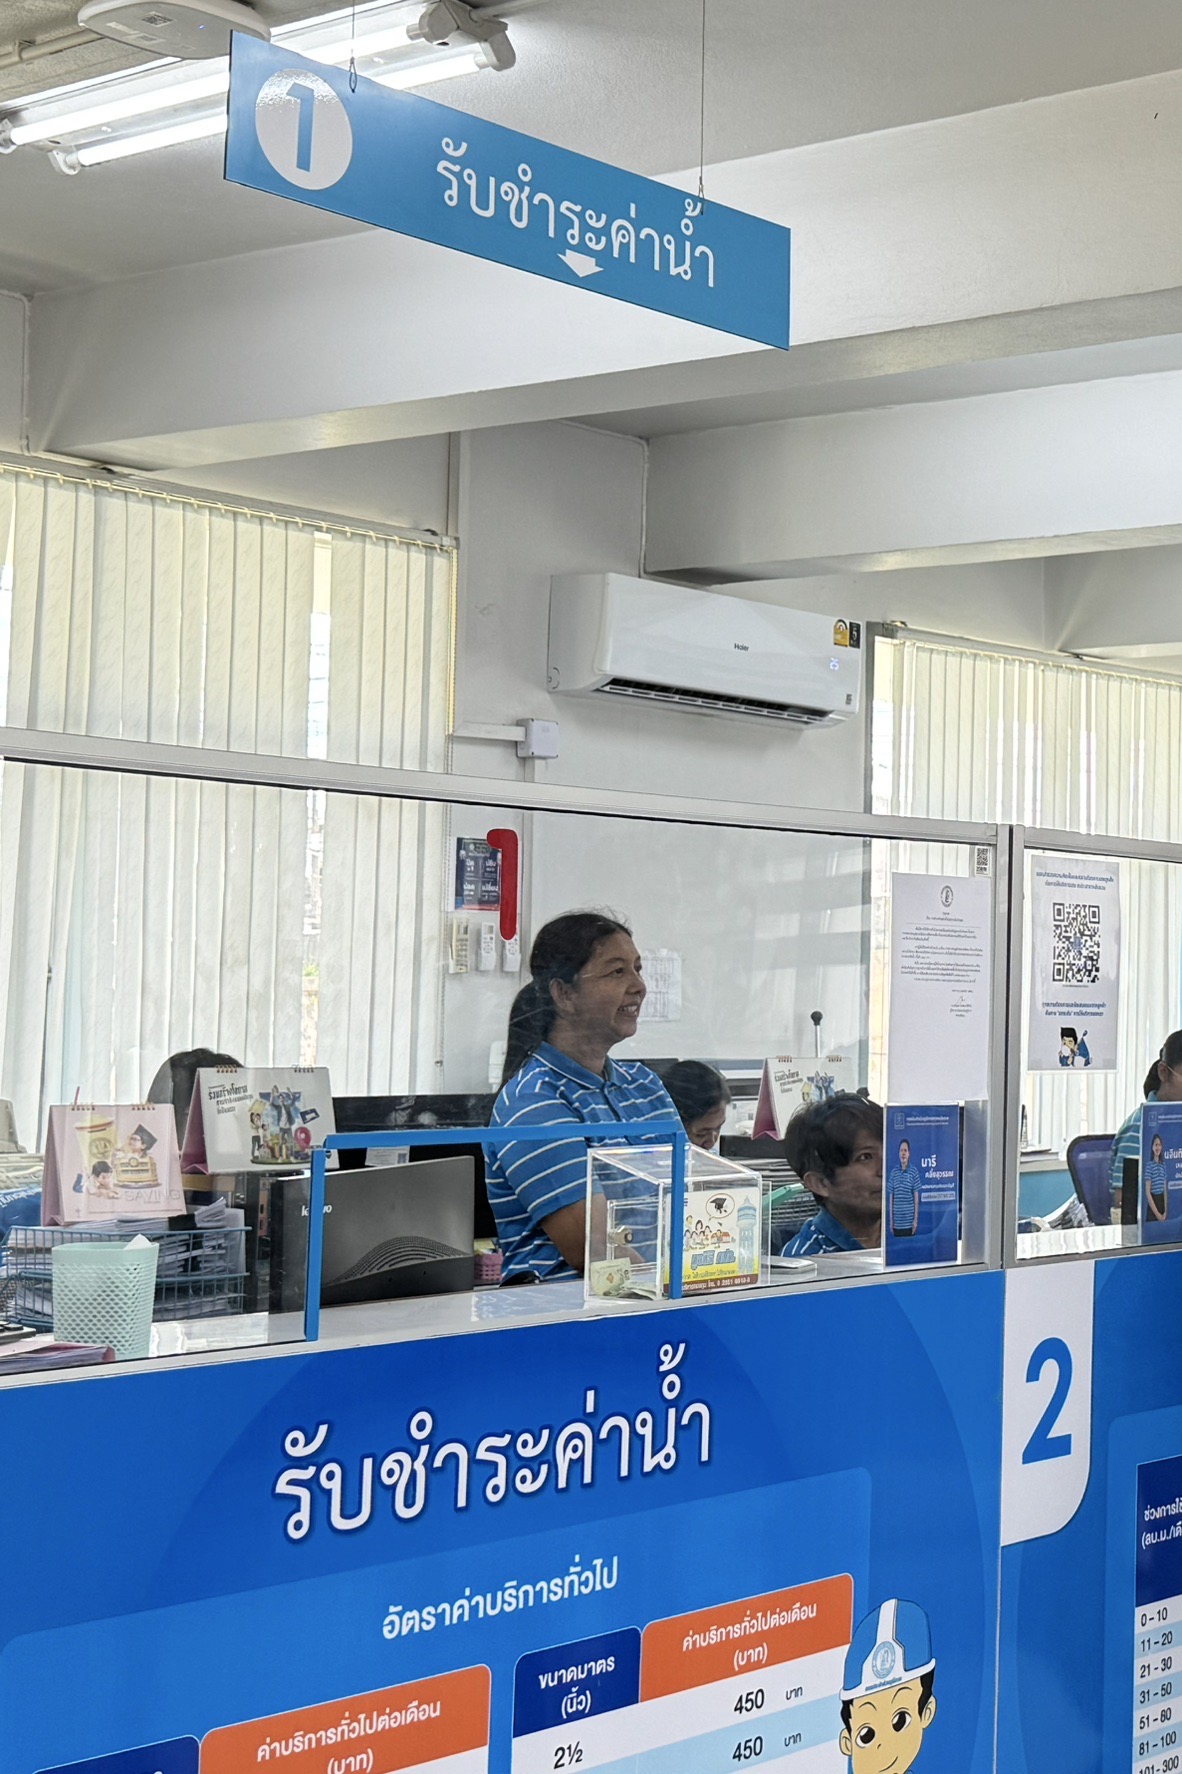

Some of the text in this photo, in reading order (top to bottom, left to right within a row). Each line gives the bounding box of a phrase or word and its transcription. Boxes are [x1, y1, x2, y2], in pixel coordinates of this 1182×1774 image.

[286, 82, 314, 173] 1
[436, 136, 715, 287] รับชำระค่าน้ำ
[487, 828, 518, 941] 1
[1022, 1337, 1073, 1465] 2
[274, 1342, 712, 1541] รับชำระค่าน้ำ
[382, 1554, 618, 1640] อัตราค่าบริการทั่วไป
[682, 1601, 817, 1653] ค่าบริการทั่วไปต่อเดือน
[1141, 1613, 1147, 1627] 0
[1157, 1607, 1168, 1622] 10
[733, 1641, 769, 1671] (บาท)
[1141, 1639, 1151, 1652] 11
[1161, 1631, 1173, 1646] 20
[538, 1654, 616, 1690] ขนาดมาตร
[1140, 1665, 1150, 1678] 21
[1161, 1656, 1172, 1672] 30
[560, 1685, 592, 1719] (นิ้ว)
[733, 1684, 803, 1716] 450 บาท
[1139, 1690, 1150, 1704] 31
[256, 1700, 442, 1762] ค่าบริการทั่วไปต่อเดือน
[1139, 1715, 1150, 1730] 51
[1160, 1707, 1172, 1723] 80
[732, 1729, 802, 1763] 450 บาท
[1139, 1741, 1149, 1756] 81
[1160, 1731, 1177, 1748] 100
[1162, 1755, 1179, 1773] 300
